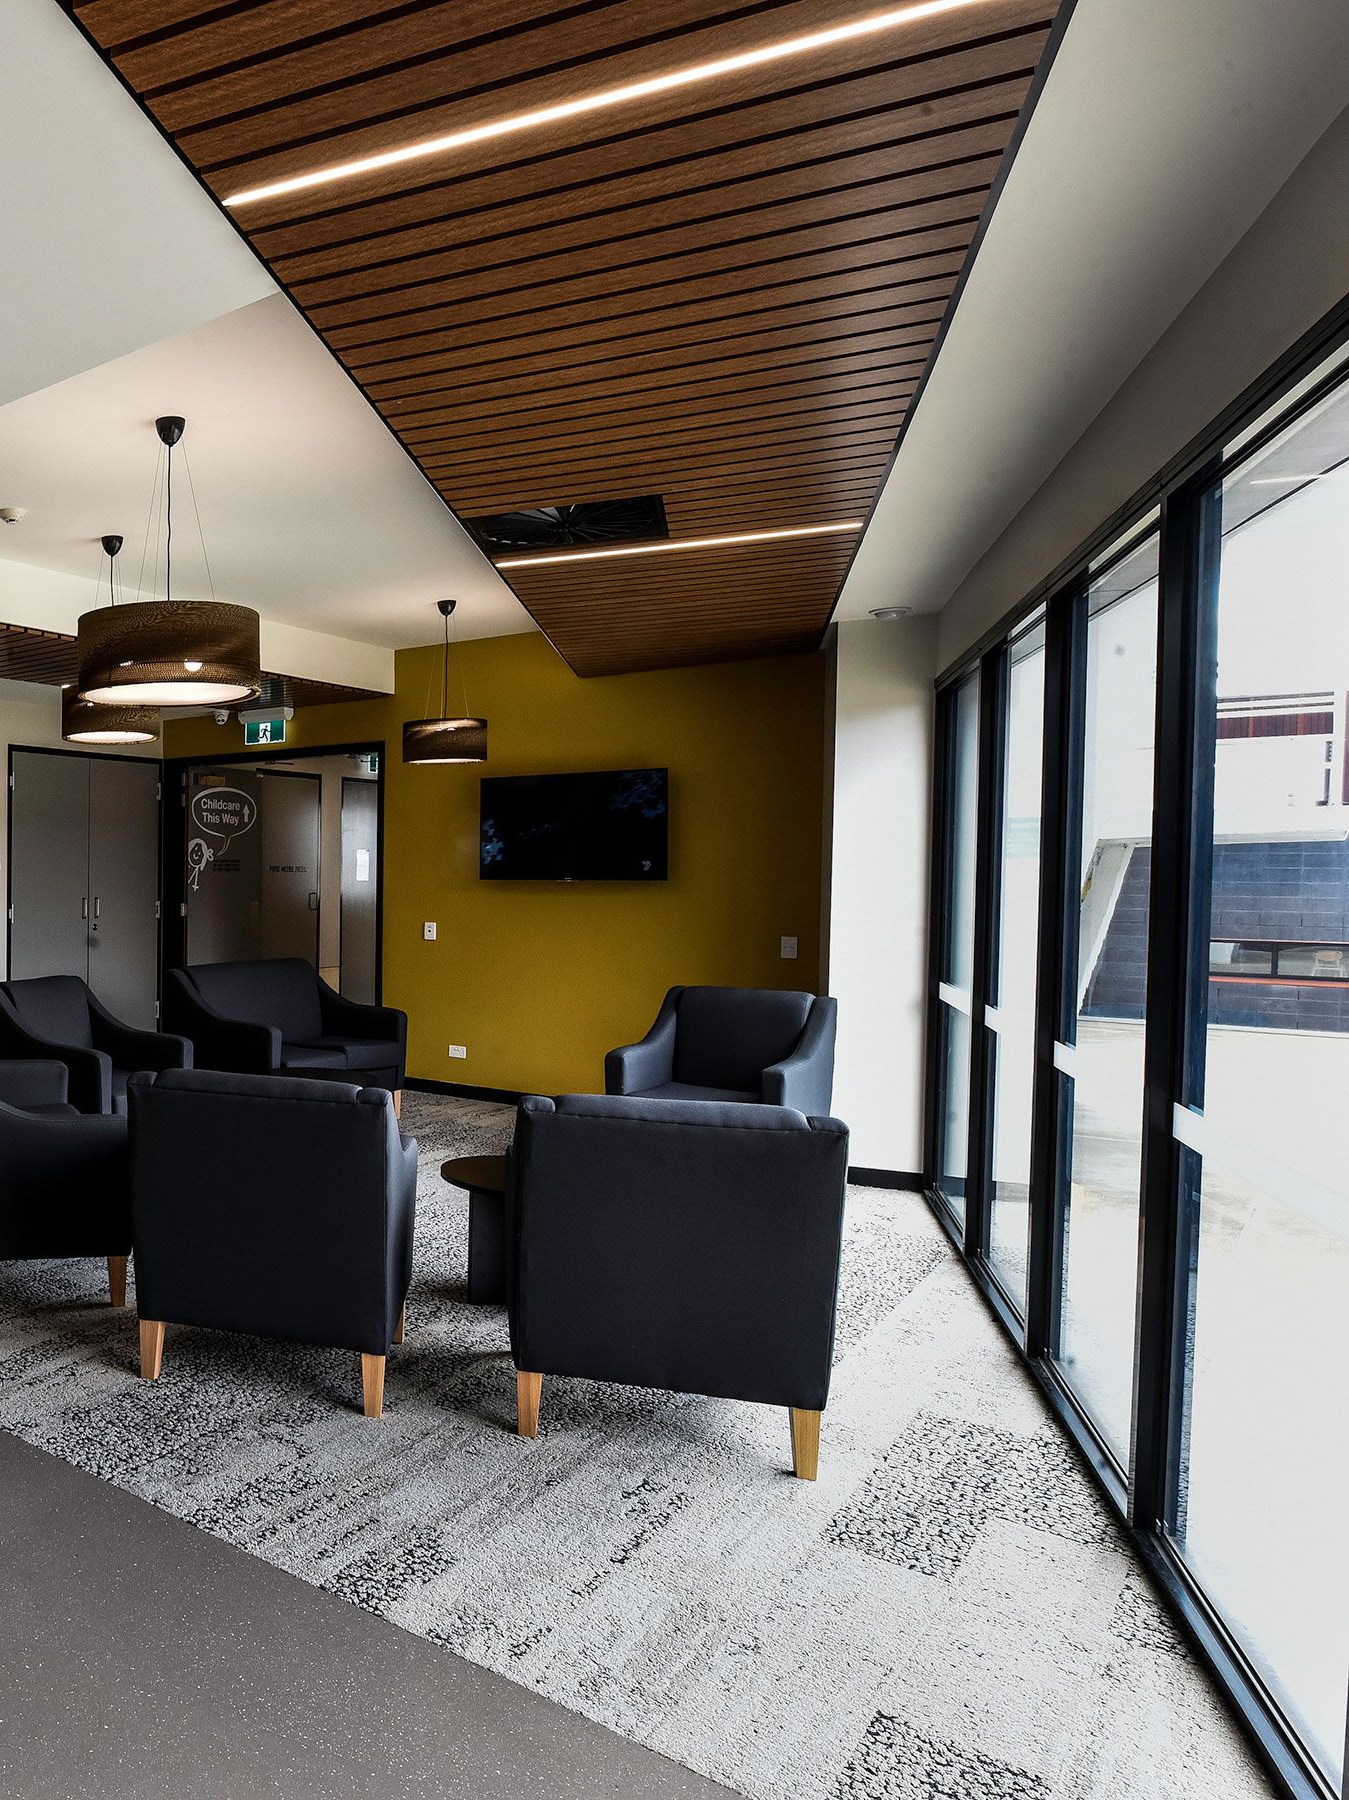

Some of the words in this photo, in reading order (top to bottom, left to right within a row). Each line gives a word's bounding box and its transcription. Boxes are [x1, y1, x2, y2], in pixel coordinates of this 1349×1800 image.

[201, 798, 240, 811] Childcare
[202, 812, 220, 824] This
[221, 813, 240, 826] Way
[269, 865, 280, 873] FIRE
[281, 865, 294, 873] HOSE
[295, 865, 307, 873] REEL
